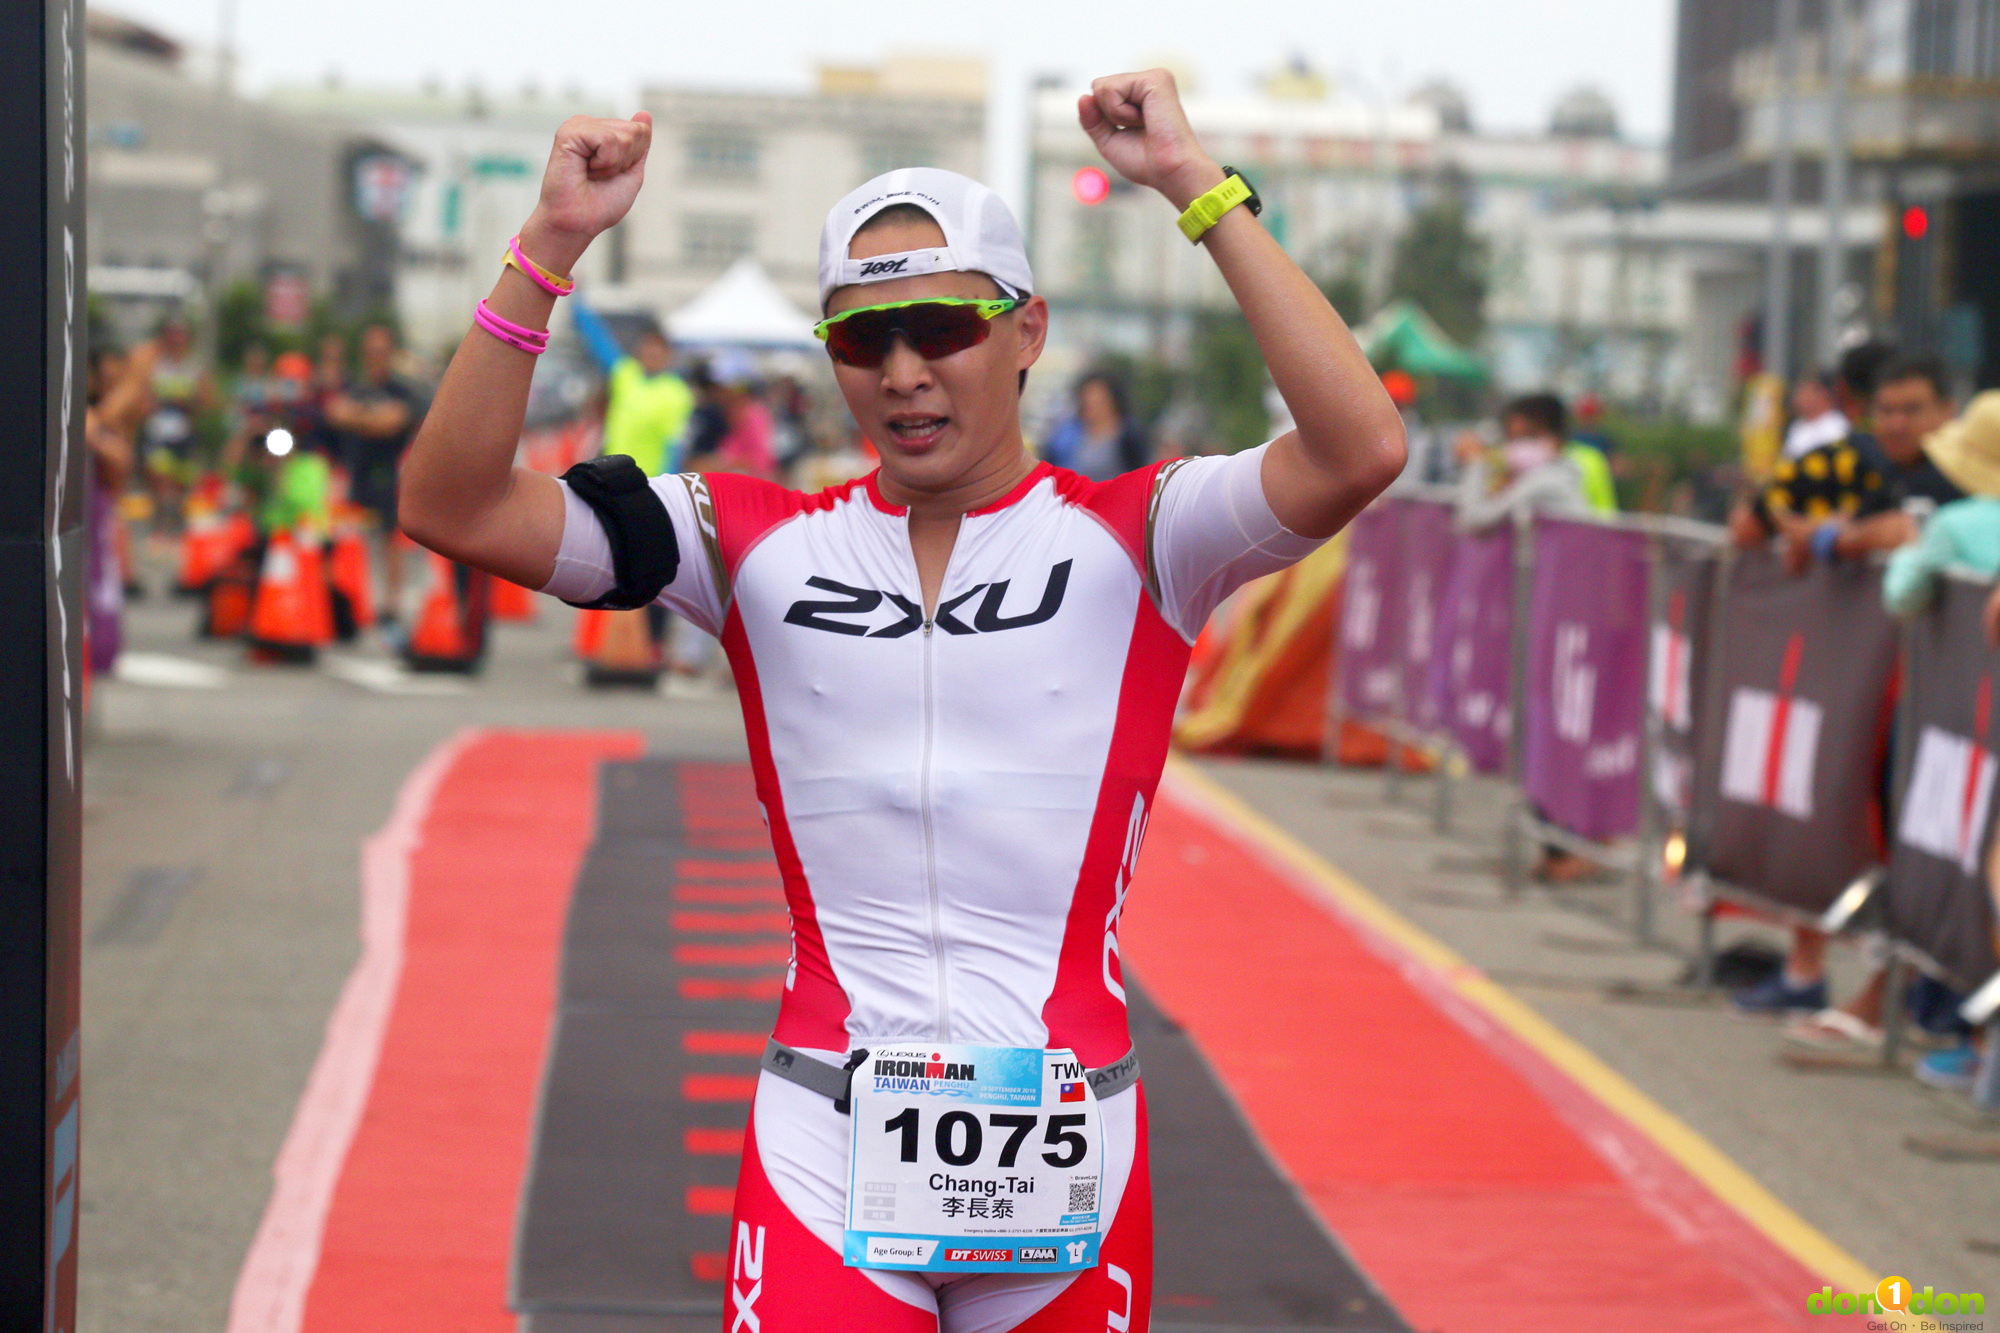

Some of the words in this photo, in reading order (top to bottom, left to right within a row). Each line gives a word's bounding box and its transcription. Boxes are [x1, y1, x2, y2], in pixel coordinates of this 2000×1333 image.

[783, 558, 1073, 639] 2XU
[874, 1076, 930, 1091] TAIWAN
[934, 1080, 970, 1089] PENGHU
[1010, 1093, 1036, 1102] TAIWAN
[885, 1107, 1088, 1168] 1075
[929, 1173, 1035, 1197] Chang-Tai
[942, 1196, 1014, 1219] 李長泰
[873, 1247, 888, 1256] Age
[916, 1246, 923, 1256] E
[950, 1250, 971, 1260] DT
[972, 1250, 1007, 1261] SWISS
